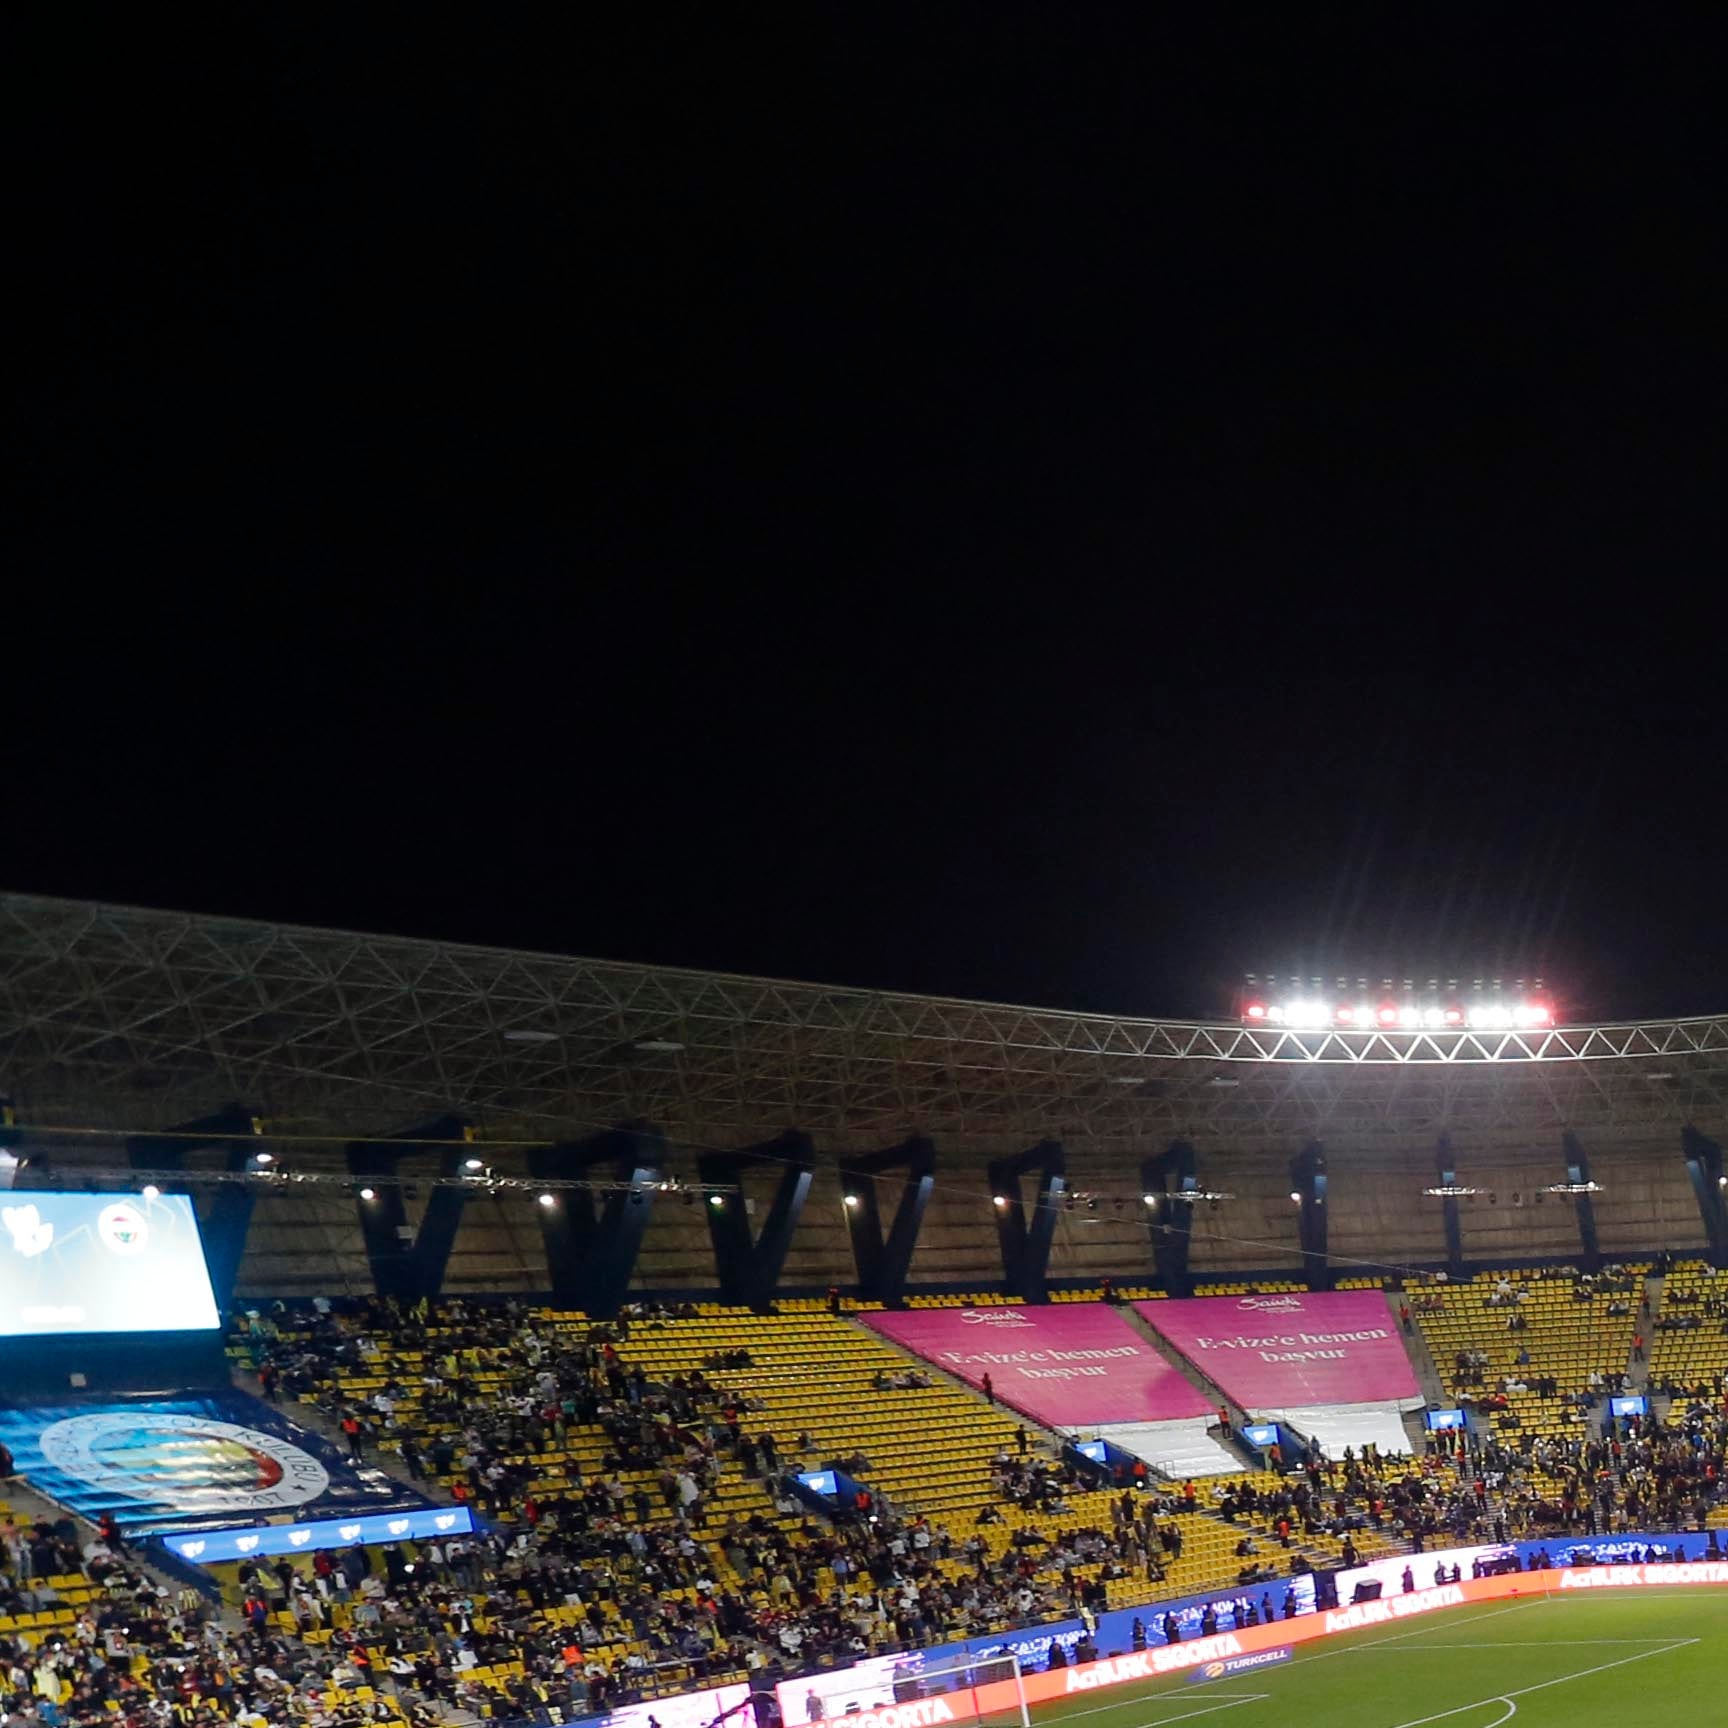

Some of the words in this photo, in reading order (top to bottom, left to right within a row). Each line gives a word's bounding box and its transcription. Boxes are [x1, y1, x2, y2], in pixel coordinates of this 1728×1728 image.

[1299, 1328, 1389, 1346] hemen
[1047, 1345, 1140, 1362] hemen
[1258, 1348, 1348, 1364] başvur
[1226, 1649, 1288, 1672] TURKCELL
